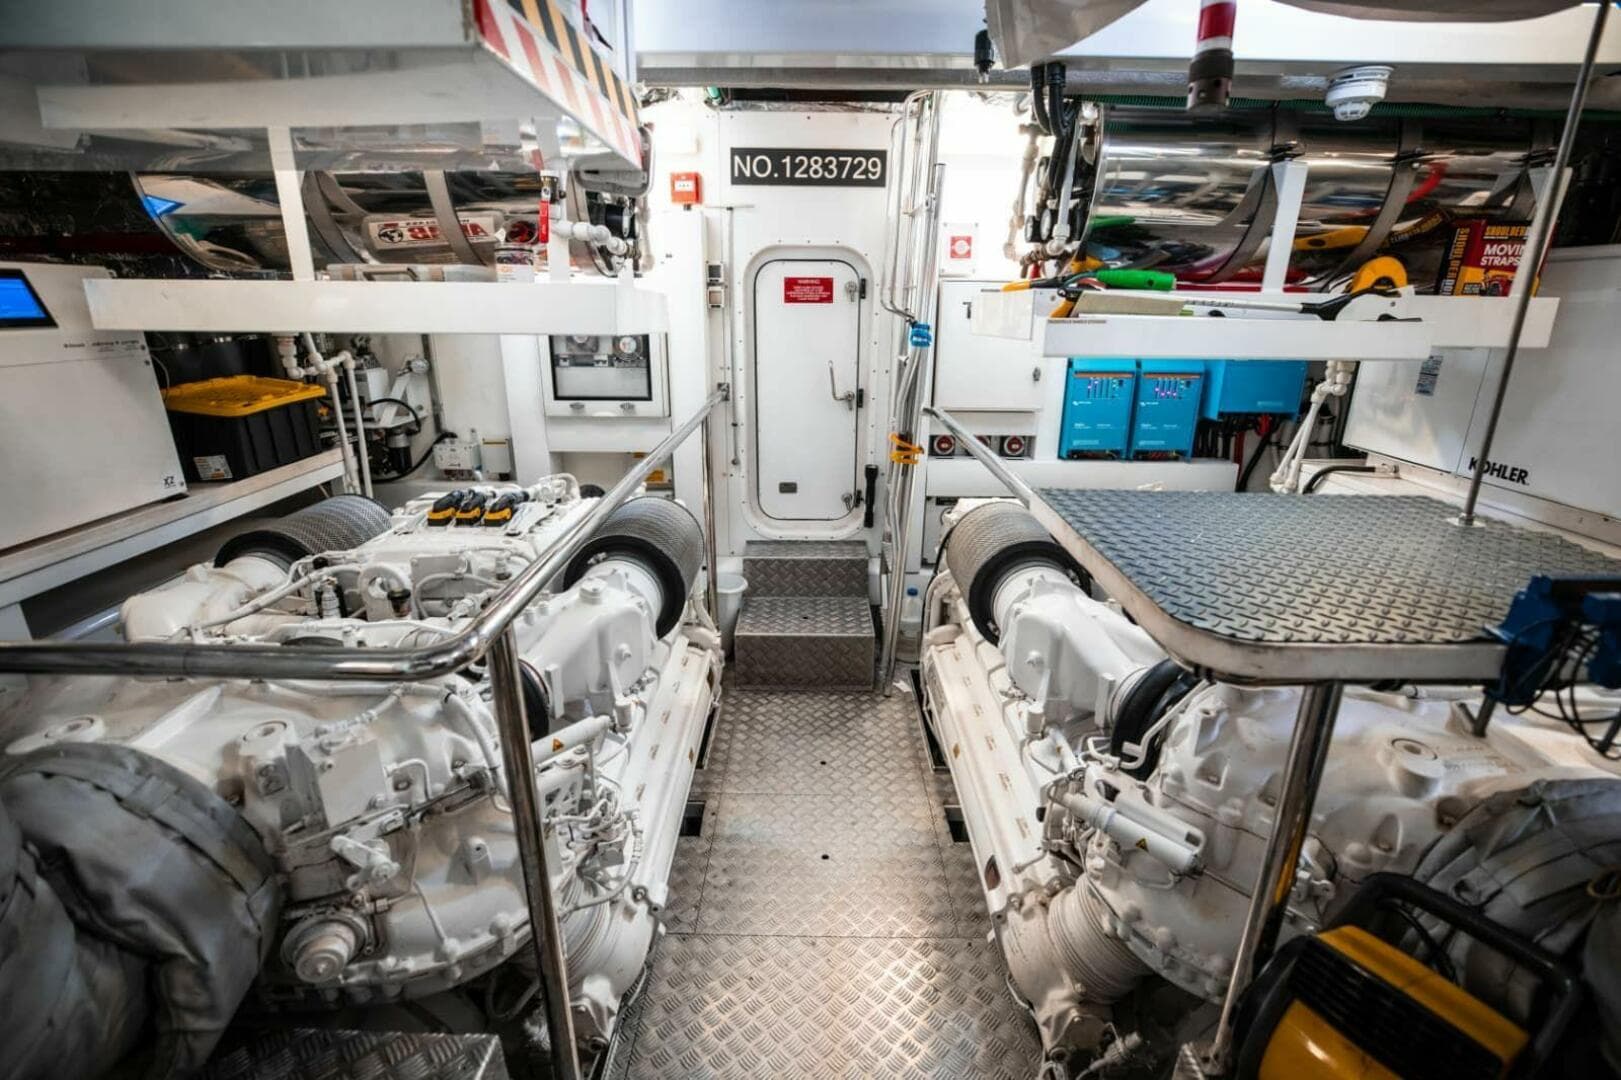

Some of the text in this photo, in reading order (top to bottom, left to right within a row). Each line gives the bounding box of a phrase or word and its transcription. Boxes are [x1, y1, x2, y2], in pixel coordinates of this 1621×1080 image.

[733, 155, 882, 179] NO.1283729
[1483, 243, 1524, 256] MOVI
[1480, 256, 1520, 267] STRAPS
